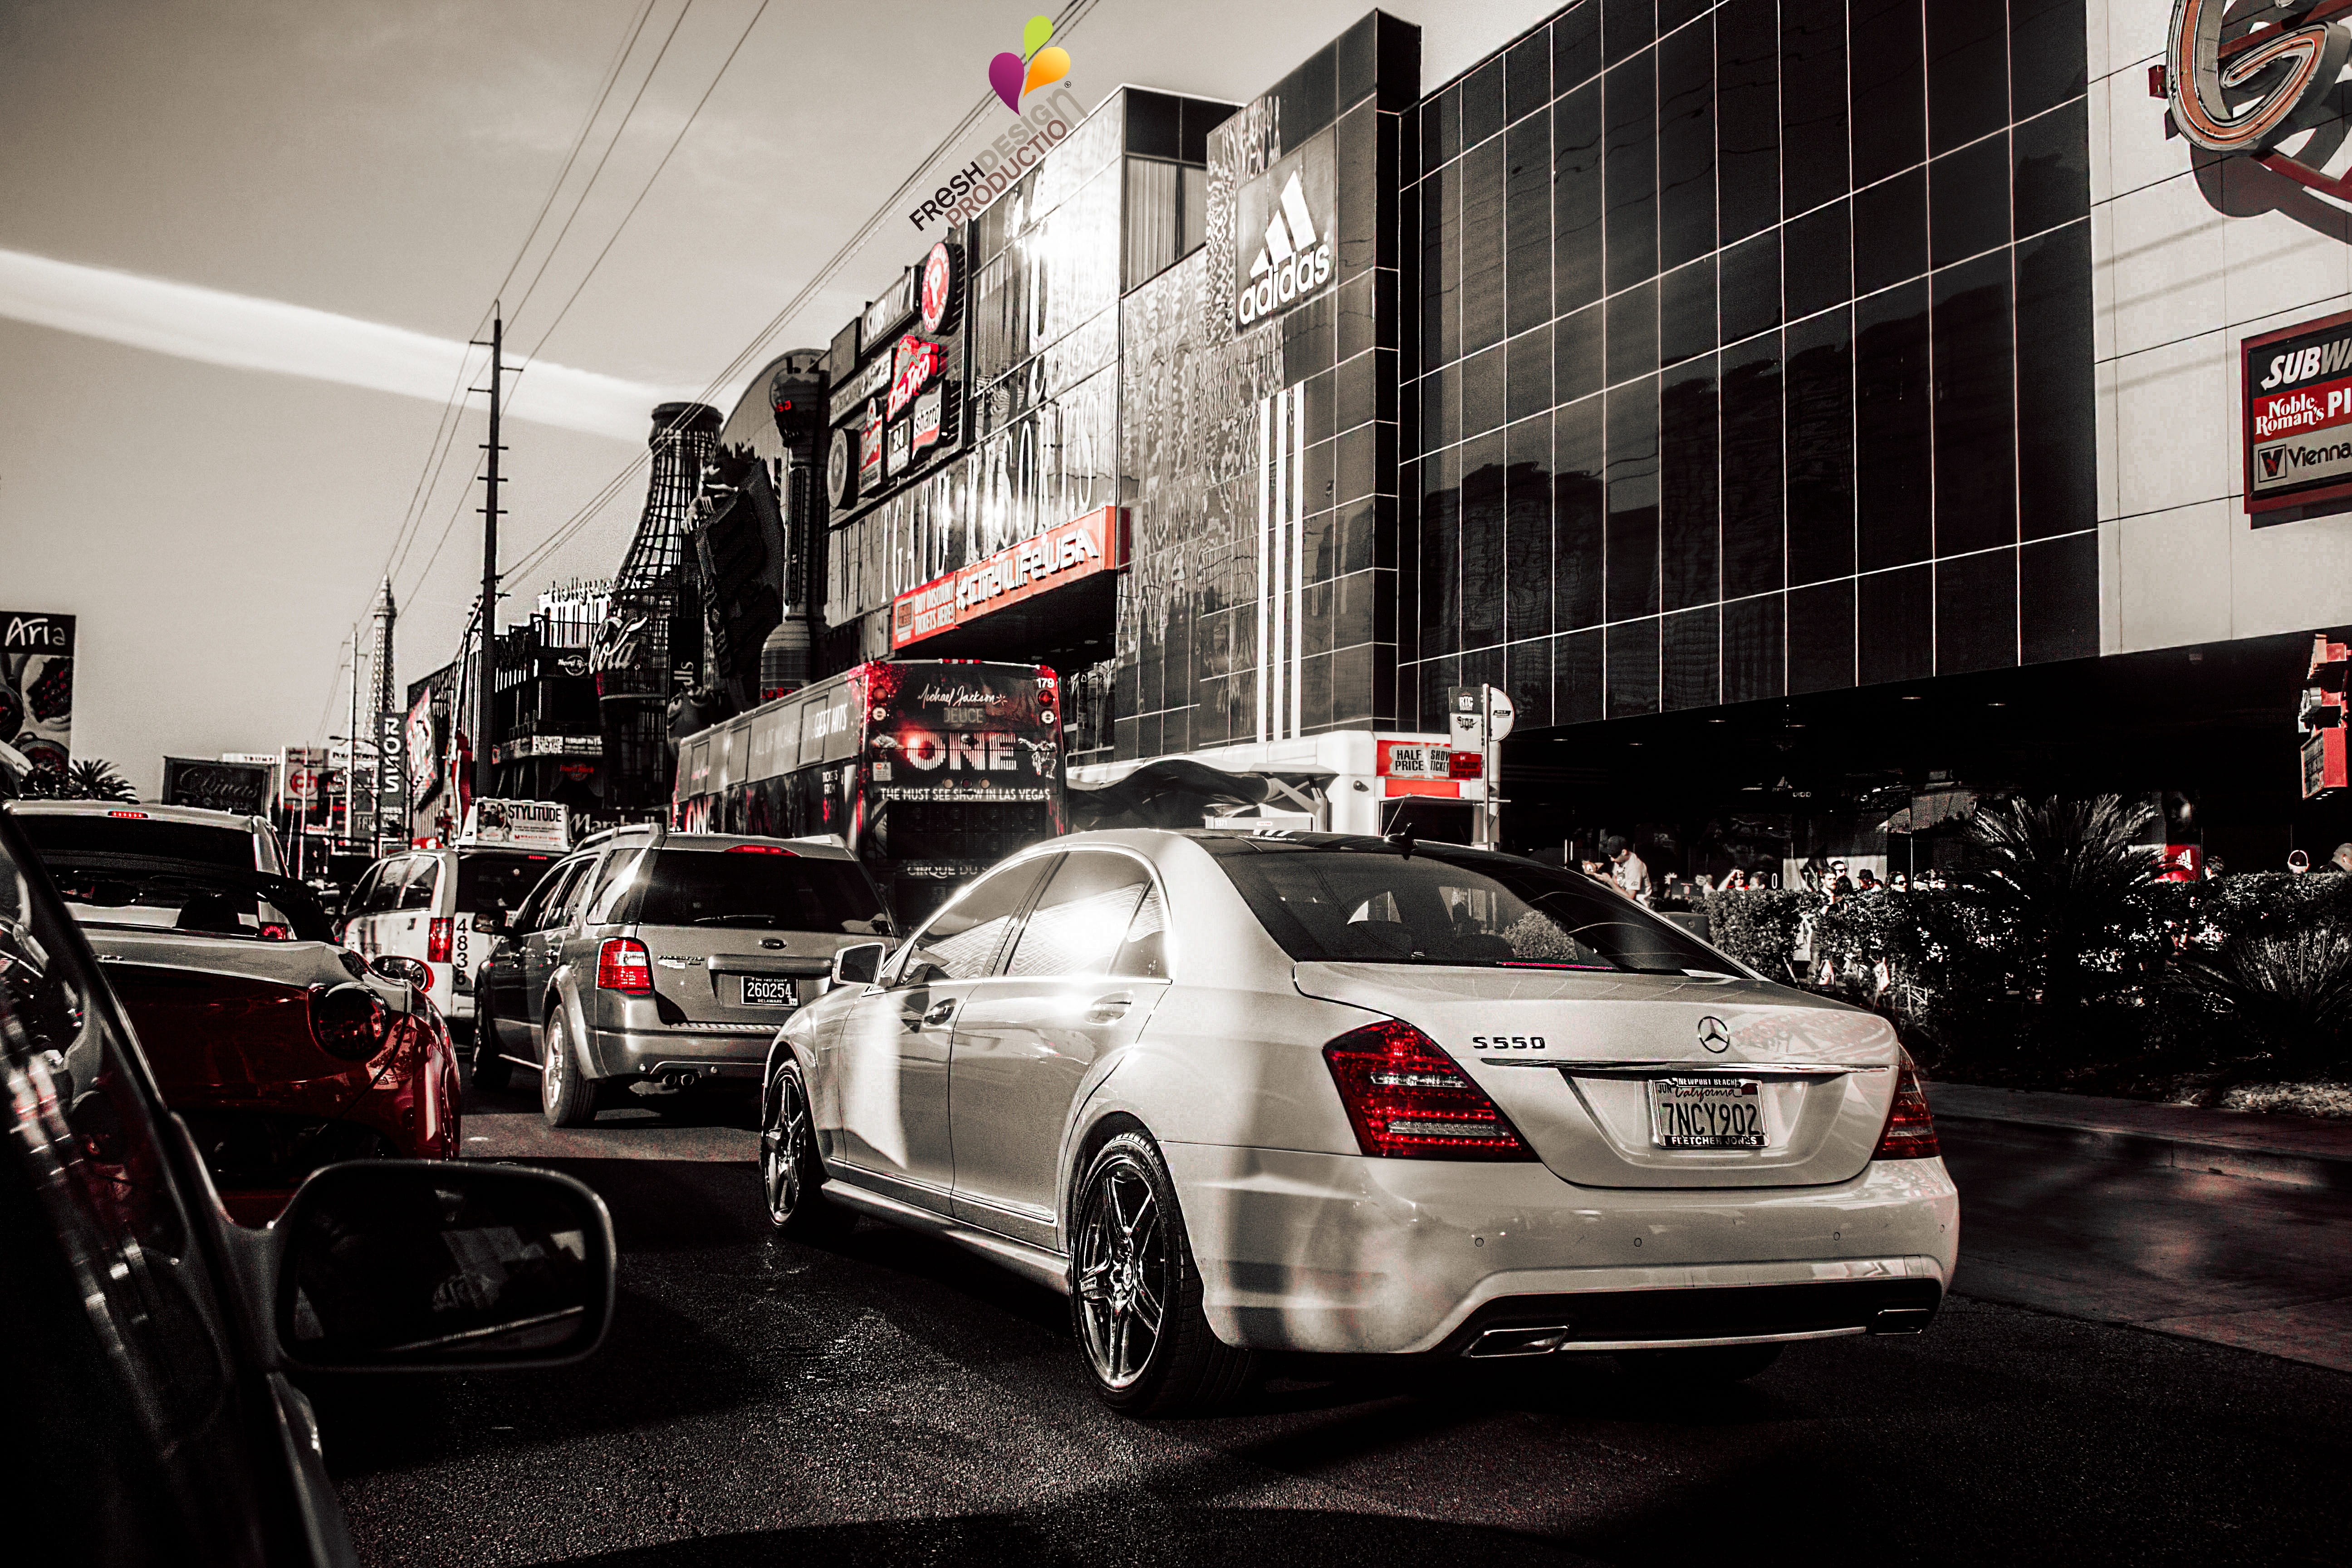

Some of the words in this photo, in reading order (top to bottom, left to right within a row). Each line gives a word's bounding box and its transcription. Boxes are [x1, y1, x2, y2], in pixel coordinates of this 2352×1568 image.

[1239, 244, 1330, 325] adidas
[2269, 393, 2316, 419] Noble
[913, 403, 940, 435] sbarro
[2255, 407, 2324, 436] Roman's
[893, 426, 904, 453] 24
[2288, 442, 2351, 468] Vienna
[914, 592, 926, 615] BUY
[926, 580, 954, 610] DISCOUNT
[5, 617, 66, 647] Aria
[914, 609, 937, 636] TICKETS
[1036, 677, 1054, 688] 179
[917, 683, 955, 709] Michael
[953, 685, 996, 706] Jackson
[1459, 696, 1474, 707] RTC
[831, 703, 848, 734] HITS
[944, 706, 984, 723] DEUCE
[383, 717, 400, 793] ROSS
[533, 743, 563, 754] ENGAGE
[907, 732, 1018, 770] ONE
[1397, 750, 1421, 760] HALF
[822, 770, 838, 783] TICKETS
[1395, 760, 1424, 771] PRICE
[823, 784, 836, 795] FROM
[880, 789, 900, 800] THE
[903, 789, 930, 800] MUST
[932, 789, 951, 800] SEE
[955, 789, 983, 800] SHOW
[986, 789, 996, 800] IN
[999, 789, 1016, 800] LAS
[1019, 789, 1050, 801] VEGAS
[508, 804, 562, 822] STYLITUDE
[907, 866, 956, 879] CIRQUE
[959, 865, 978, 875] DU
[455, 918, 468, 985] 4836
[747, 982, 792, 998] 260254
[1658, 1085, 1672, 1093] JUN
[1675, 1088, 1743, 1102] California
[1662, 1102, 1760, 1136] 7NCY902
[1671, 1136, 1722, 1145] FLETCHER
[1725, 1136, 1757, 1145] JONES
